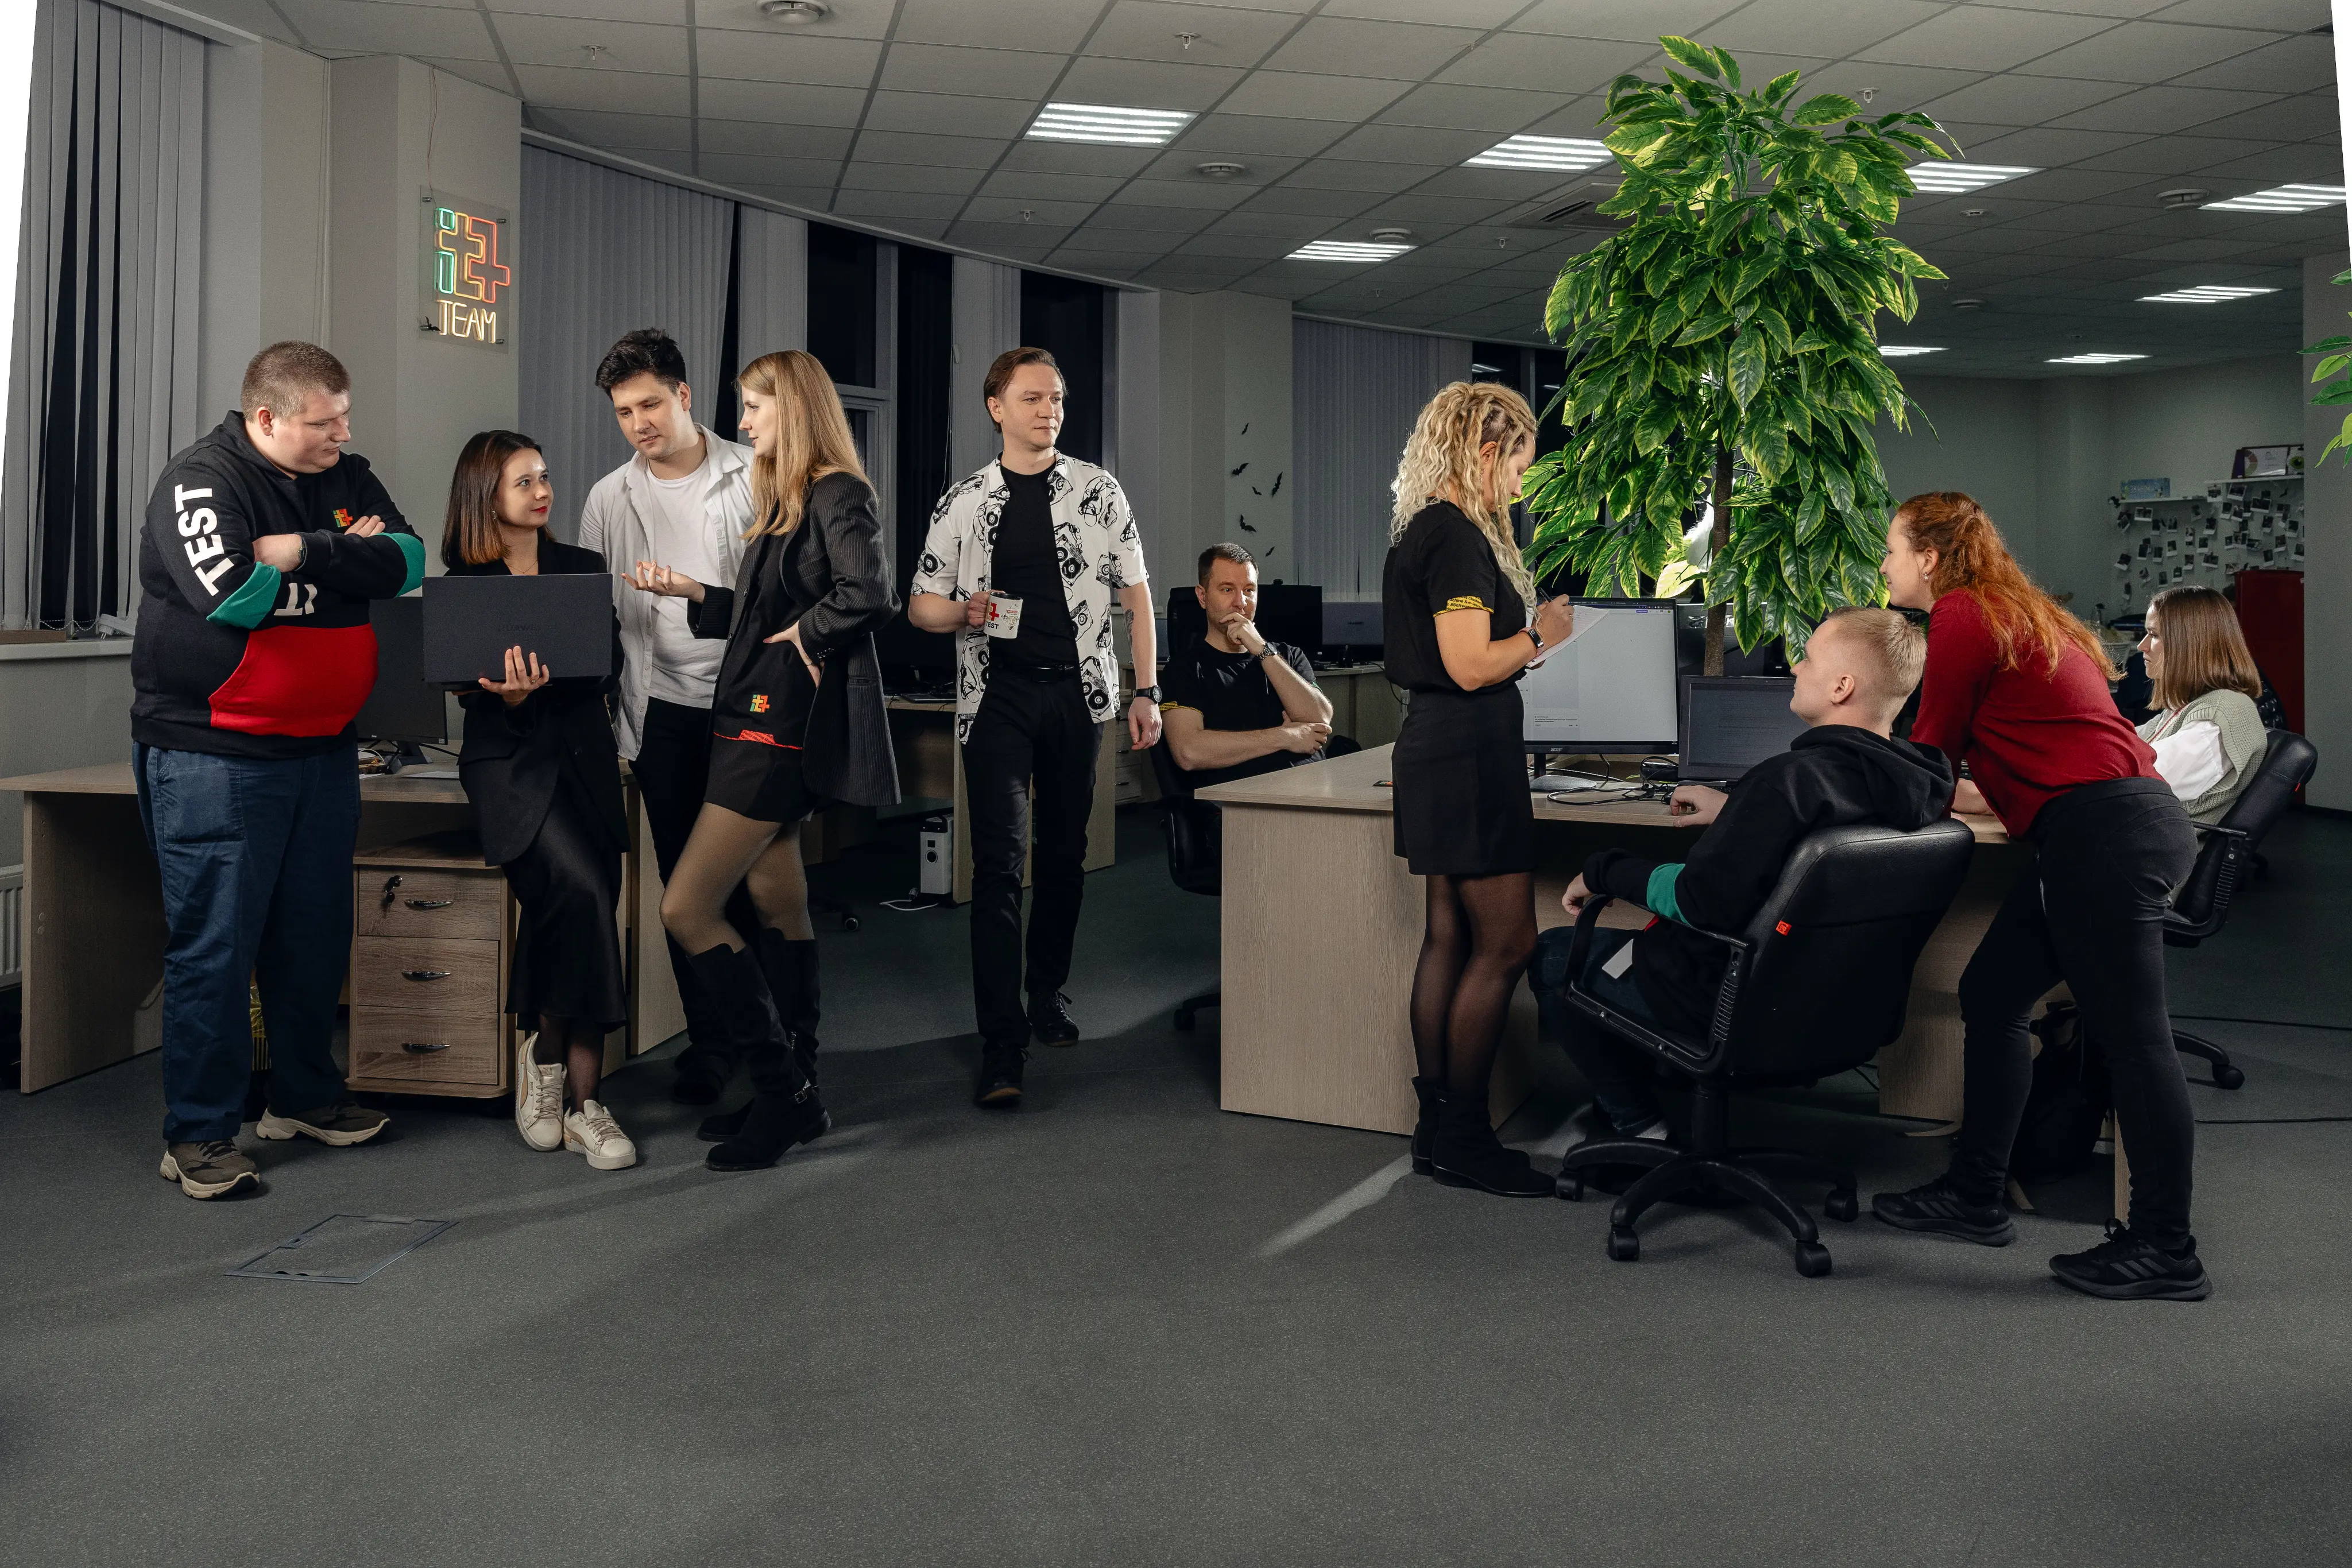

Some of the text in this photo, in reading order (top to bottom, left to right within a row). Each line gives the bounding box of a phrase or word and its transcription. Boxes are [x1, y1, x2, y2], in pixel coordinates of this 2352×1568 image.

[436, 299, 497, 344] TEAM
[175, 483, 234, 597] TEST
[986, 621, 999, 630] TEST
